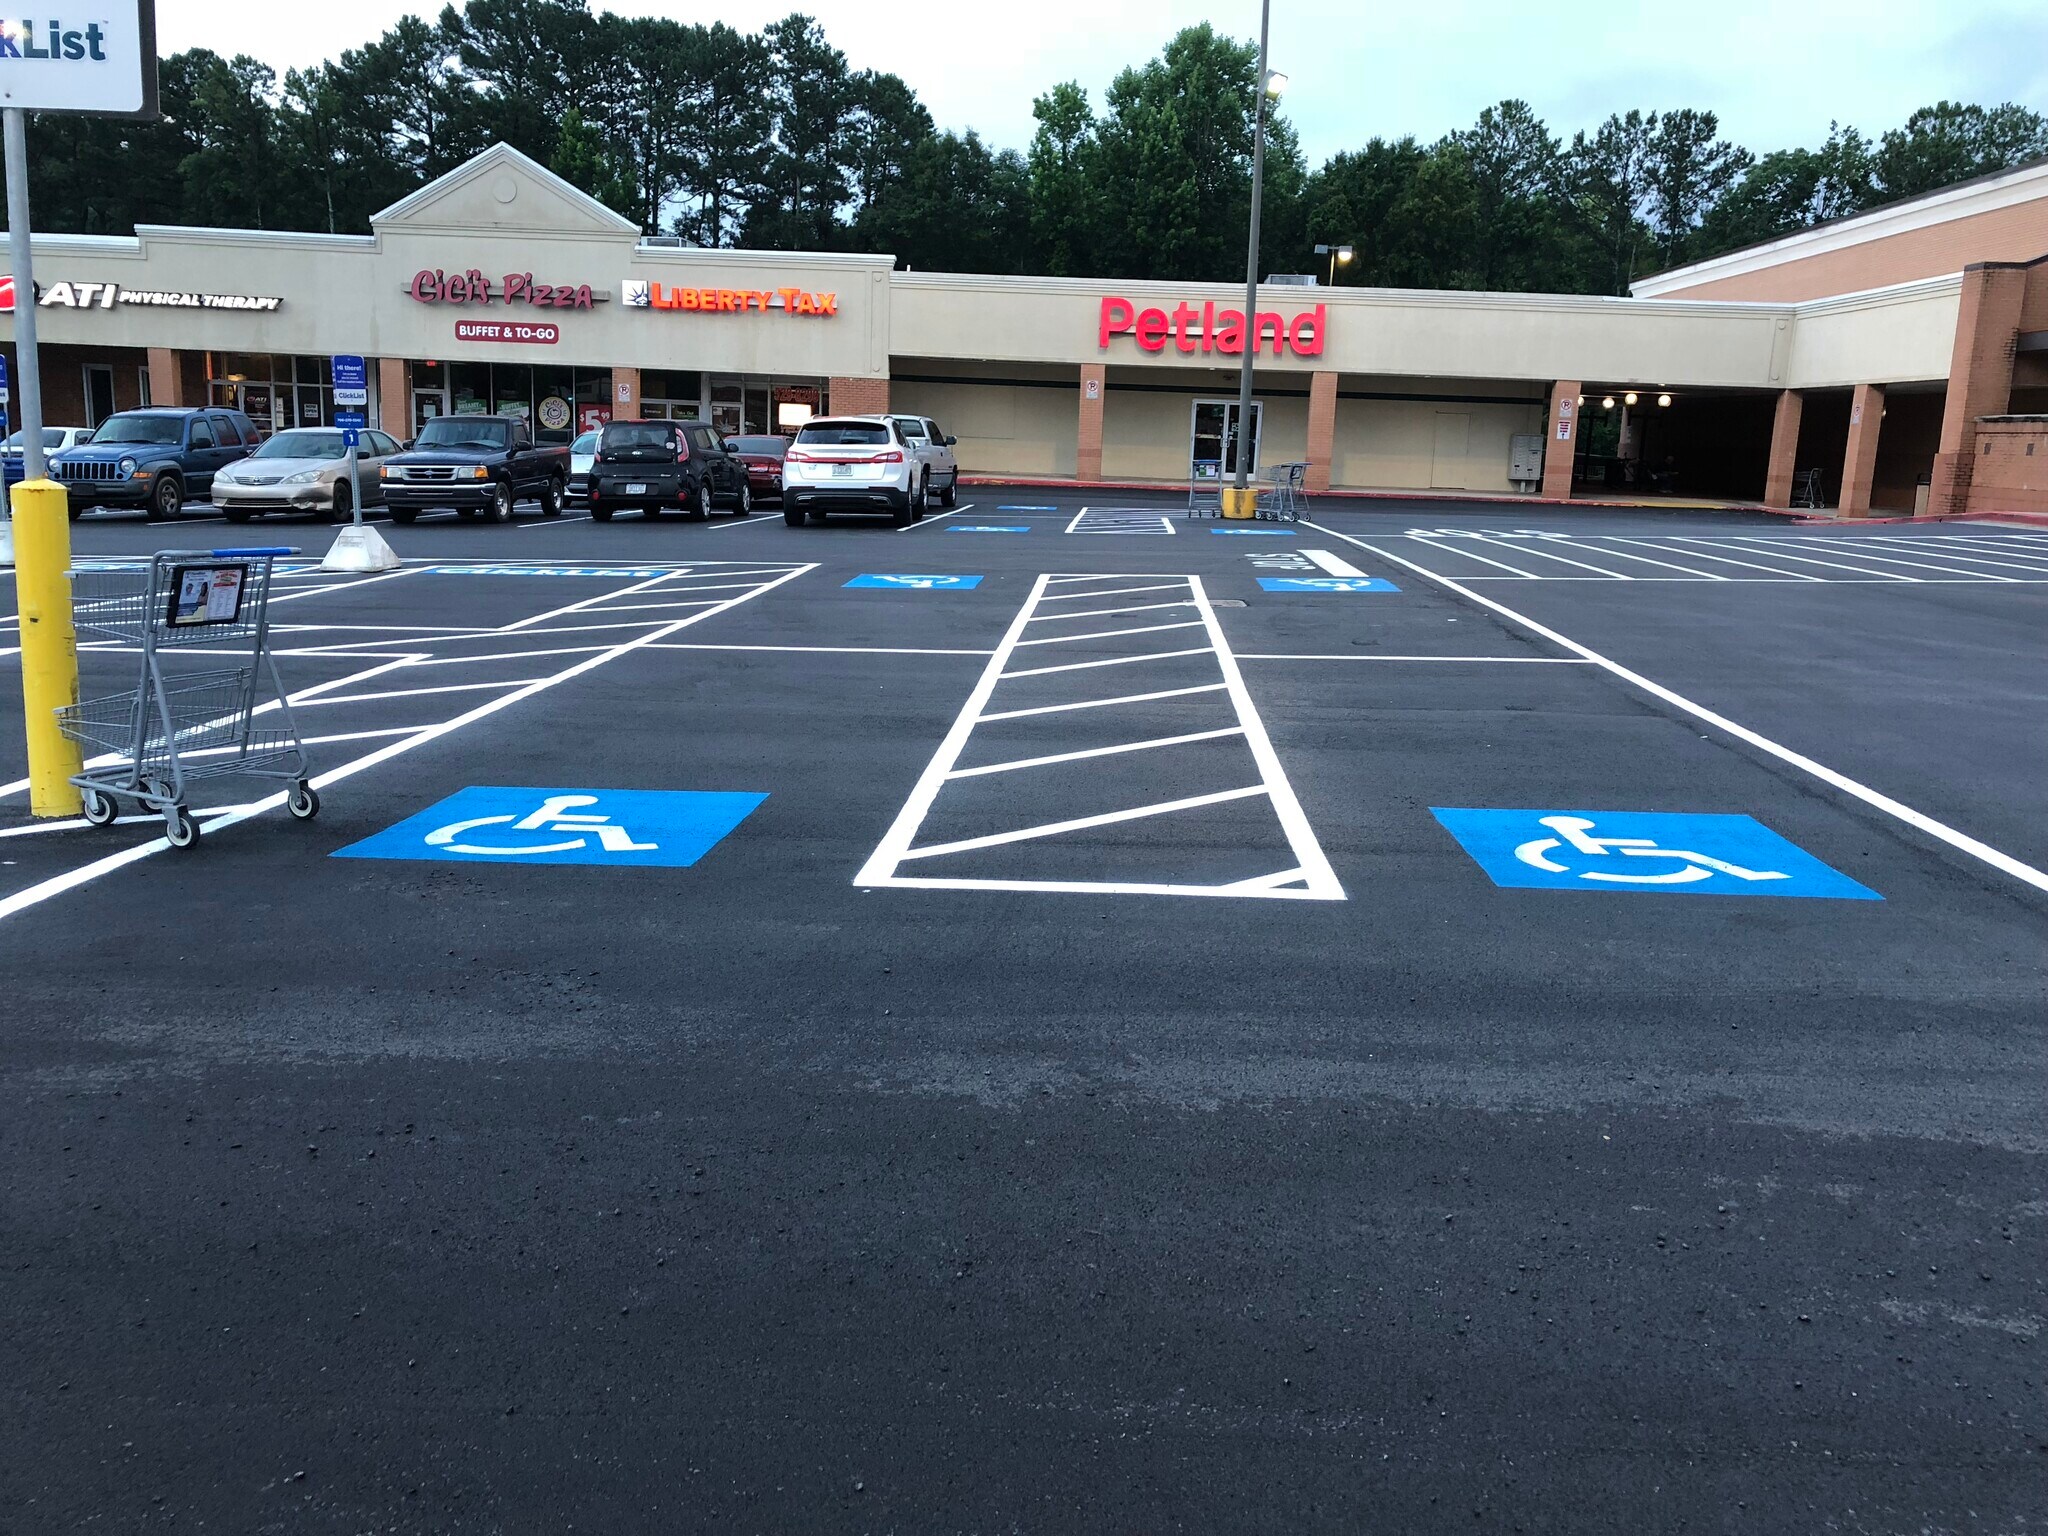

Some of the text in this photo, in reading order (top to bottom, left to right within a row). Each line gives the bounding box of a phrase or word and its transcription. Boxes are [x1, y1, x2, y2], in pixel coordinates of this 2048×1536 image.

[39, 281, 284, 311] ATI PHYSICAL THERAPY
[651, 282, 836, 315] LIBERTY TAX
[459, 325, 555, 339] BUFFET & TO-GO
[1100, 297, 1326, 355] Petland
[338, 391, 365, 399] ClickList
[348, 433, 354, 444] 1
